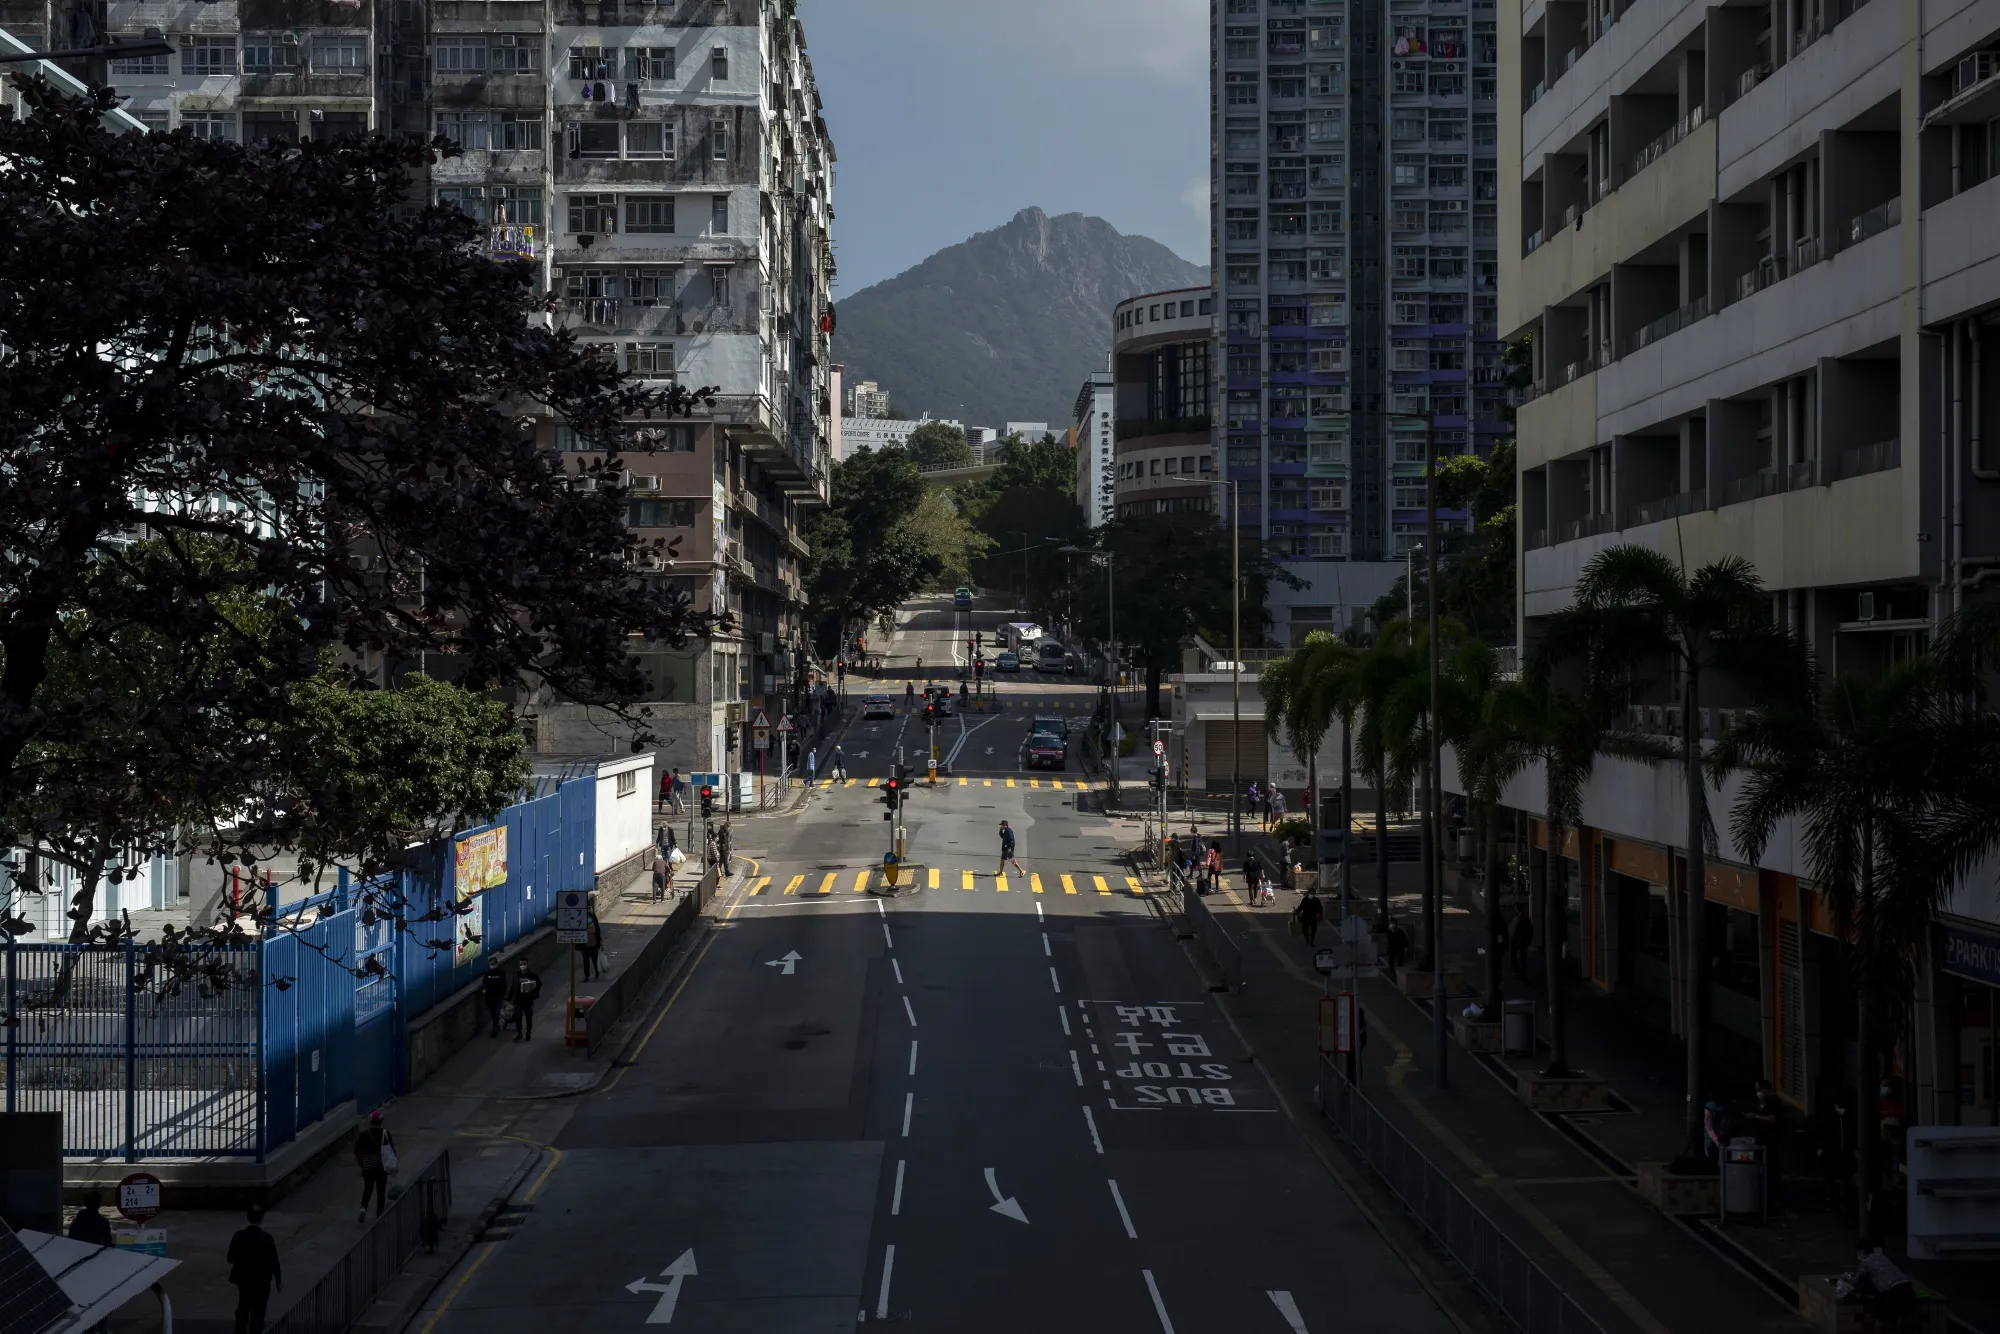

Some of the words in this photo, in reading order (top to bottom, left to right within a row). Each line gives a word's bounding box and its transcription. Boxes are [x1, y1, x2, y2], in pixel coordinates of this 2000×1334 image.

[1115, 1006, 1182, 1027] 站
[1114, 1033, 1212, 1057] 巴士
[1116, 1062, 1232, 1080] STOP
[1134, 1085, 1236, 1106] BUS
[125, 1198, 138, 1207] 214
